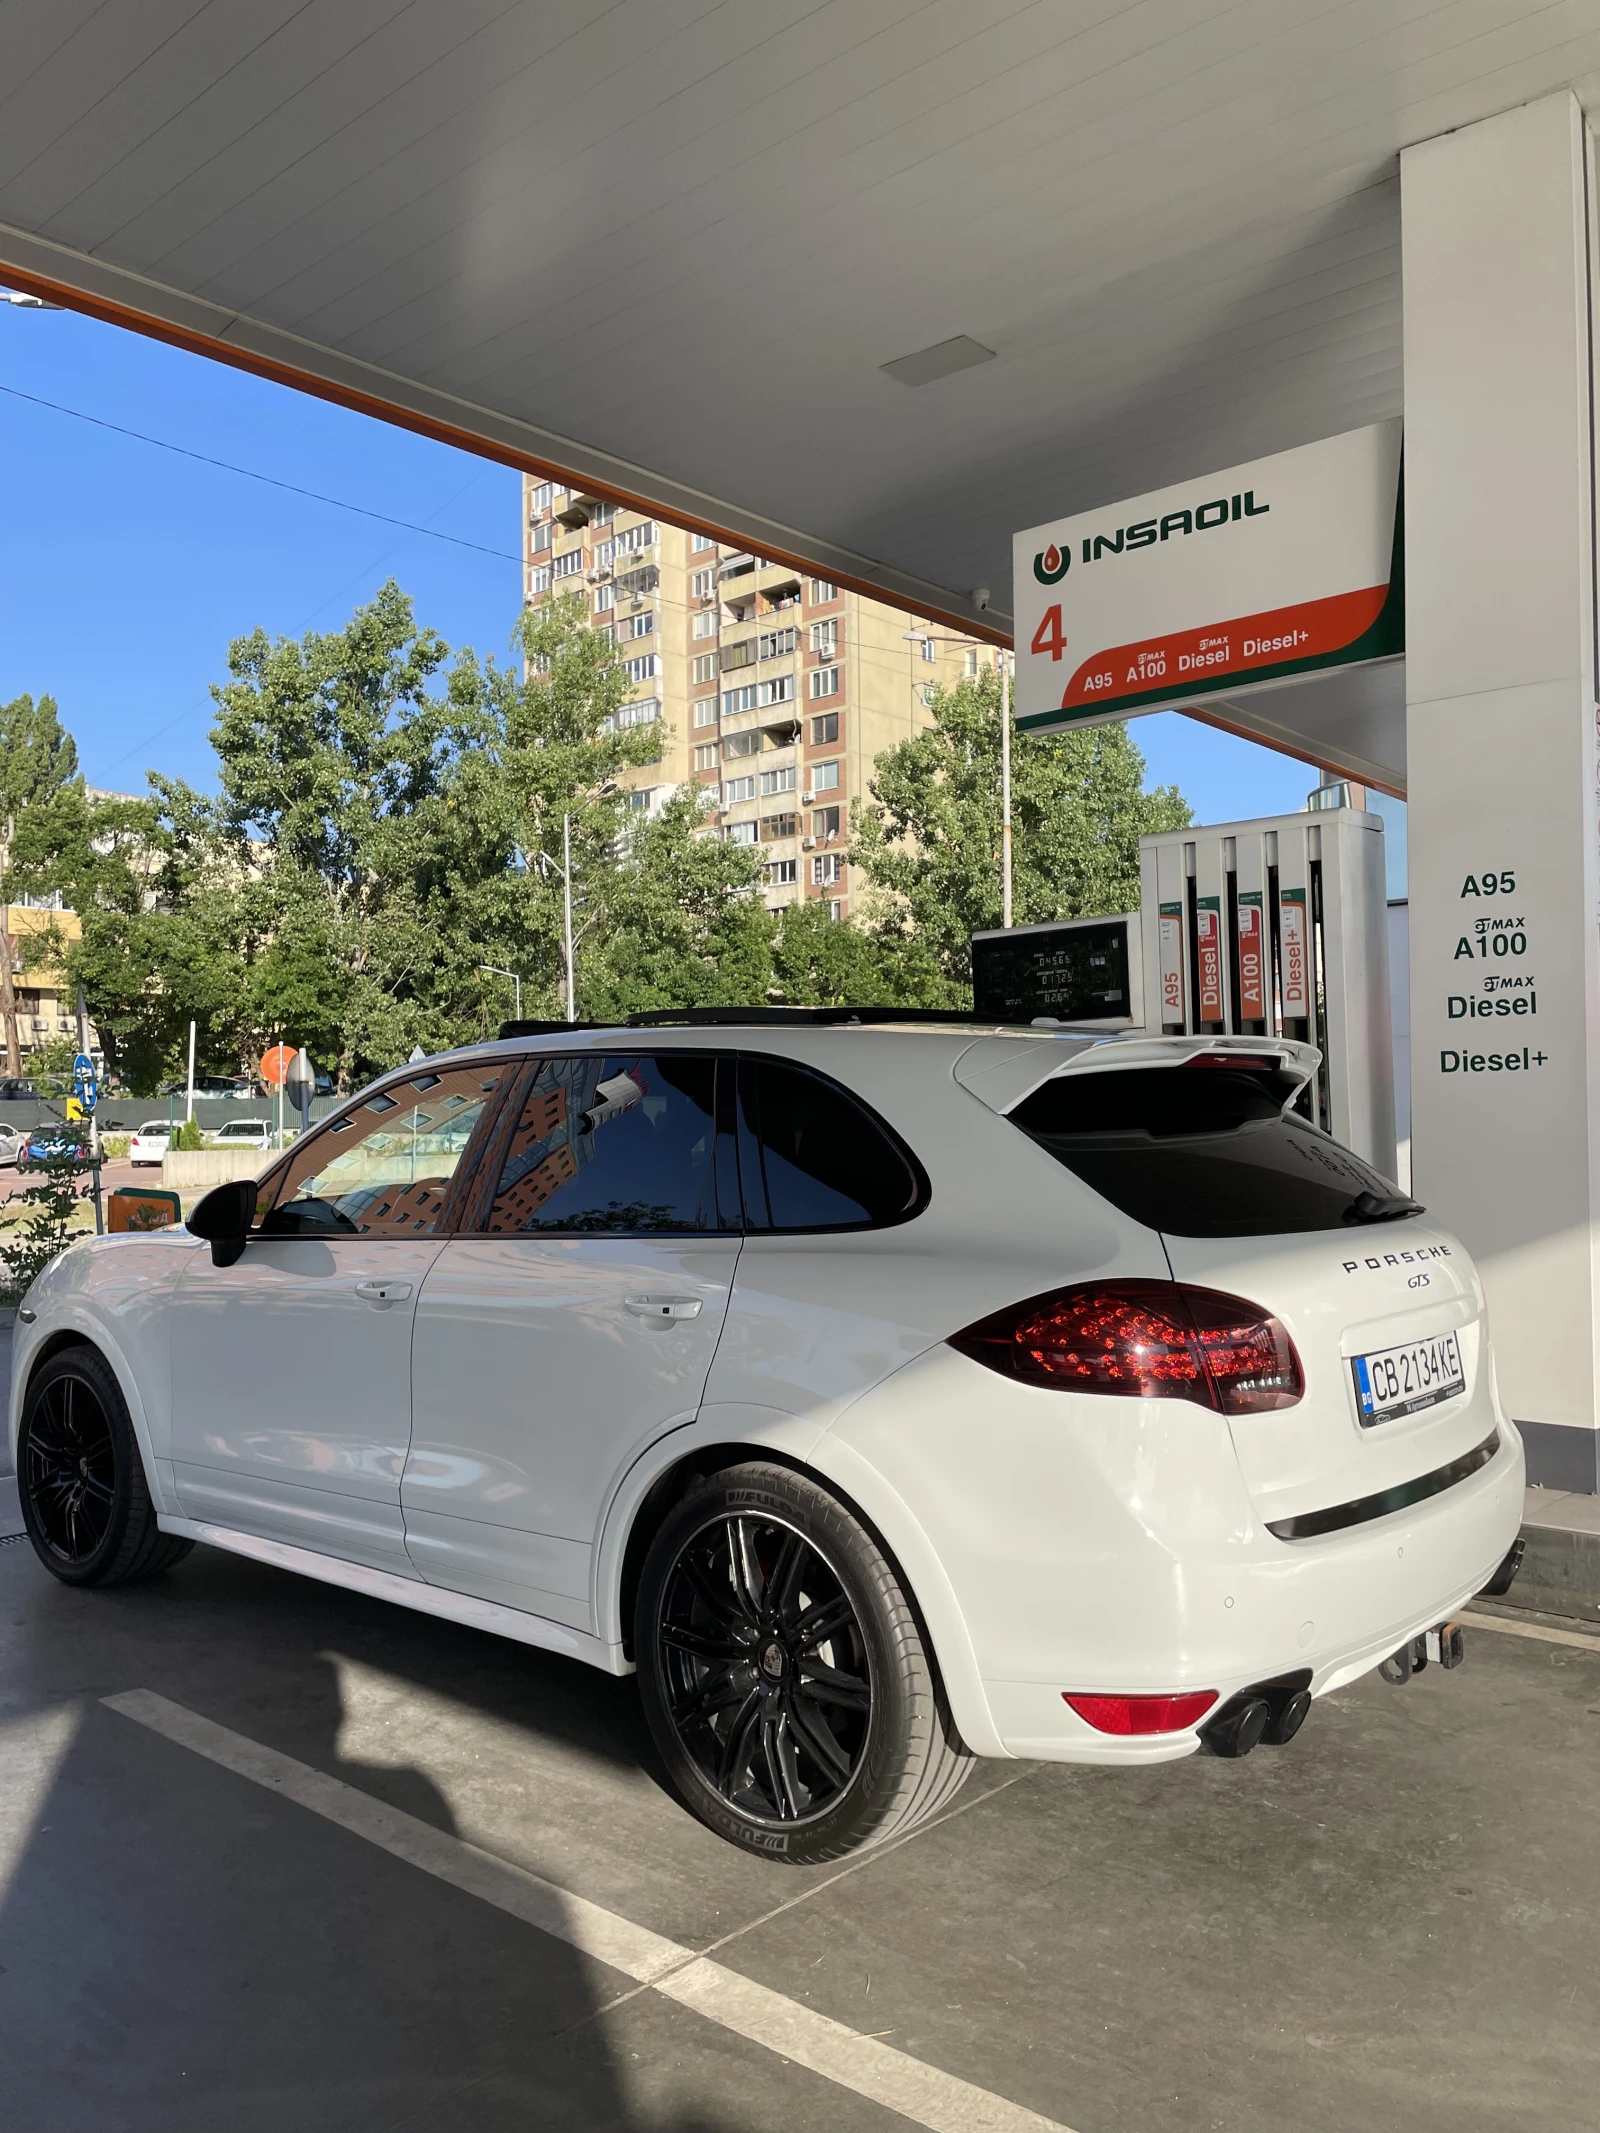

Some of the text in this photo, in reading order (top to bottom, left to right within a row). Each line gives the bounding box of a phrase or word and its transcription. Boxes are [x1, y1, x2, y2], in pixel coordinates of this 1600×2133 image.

[1082, 490, 1270, 563] INSAOIL
[1030, 603, 1067, 662] 4
[1083, 629, 1309, 692] A95 A100 Diesel Diesel+
[1460, 871, 1516, 899] A95
[1453, 932, 1527, 960] A100
[1201, 947, 1217, 1005] Diesel
[1243, 953, 1260, 1002] A100
[1285, 929, 1302, 1001] Diesel+
[1164, 972, 1179, 1008] A95
[1447, 992, 1537, 1019] Diesel
[1440, 1047, 1548, 1073] Diesel+
[1342, 1245, 1452, 1274] PORSCHE
[1407, 1273, 1430, 1289] GTS
[1362, 1392, 1371, 1405] BG
[744, 1491, 807, 1526] FULDA
